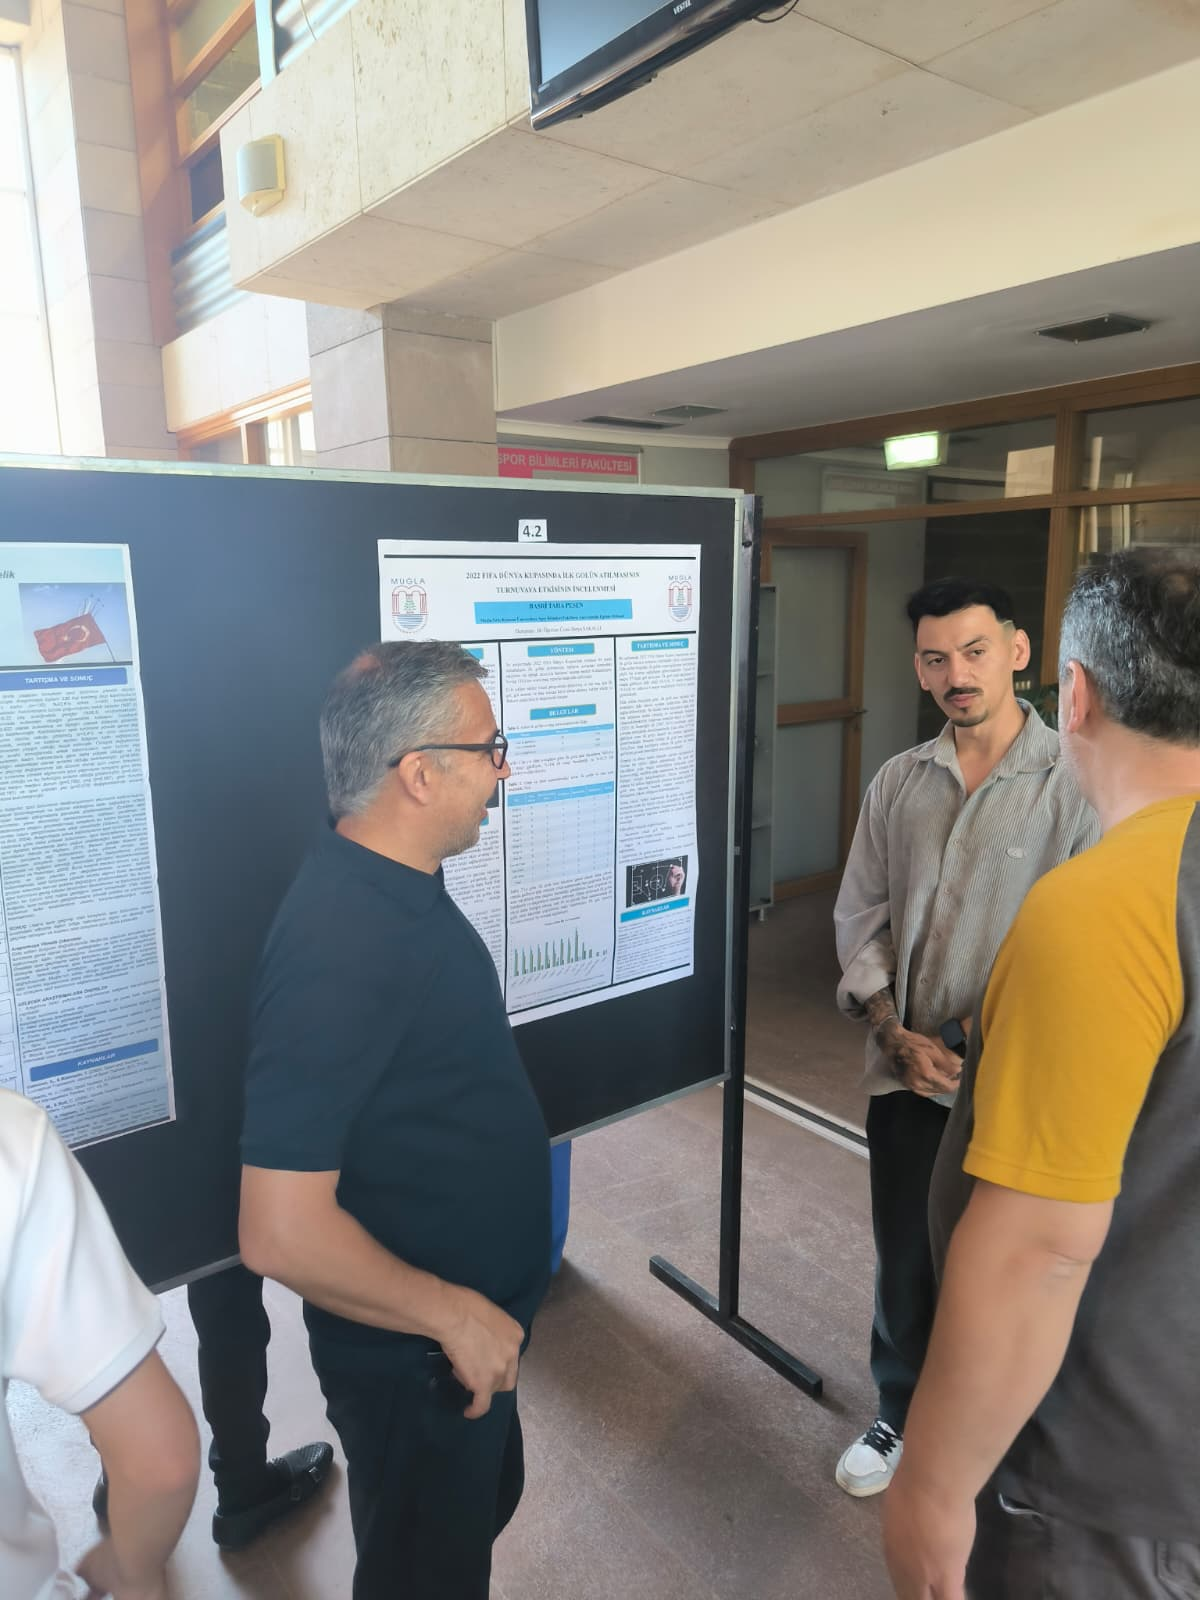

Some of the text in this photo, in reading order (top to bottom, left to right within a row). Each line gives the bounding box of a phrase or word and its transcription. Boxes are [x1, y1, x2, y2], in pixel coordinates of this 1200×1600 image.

[528, 454, 579, 469] BİLİMLERİ
[581, 456, 632, 472] FAKÜLTESİ
[522, 525, 542, 537] 4.2
[466, 571, 480, 579] 2022
[482, 571, 498, 579] FIFA
[499, 570, 523, 579] DÜNYA
[524, 570, 561, 579] KUPASINDA
[562, 569, 574, 579] İLK
[576, 570, 598, 578] GOLÜN
[496, 586, 537, 594] TURNUVAYA
[538, 585, 571, 593] ETKİSİNİN
